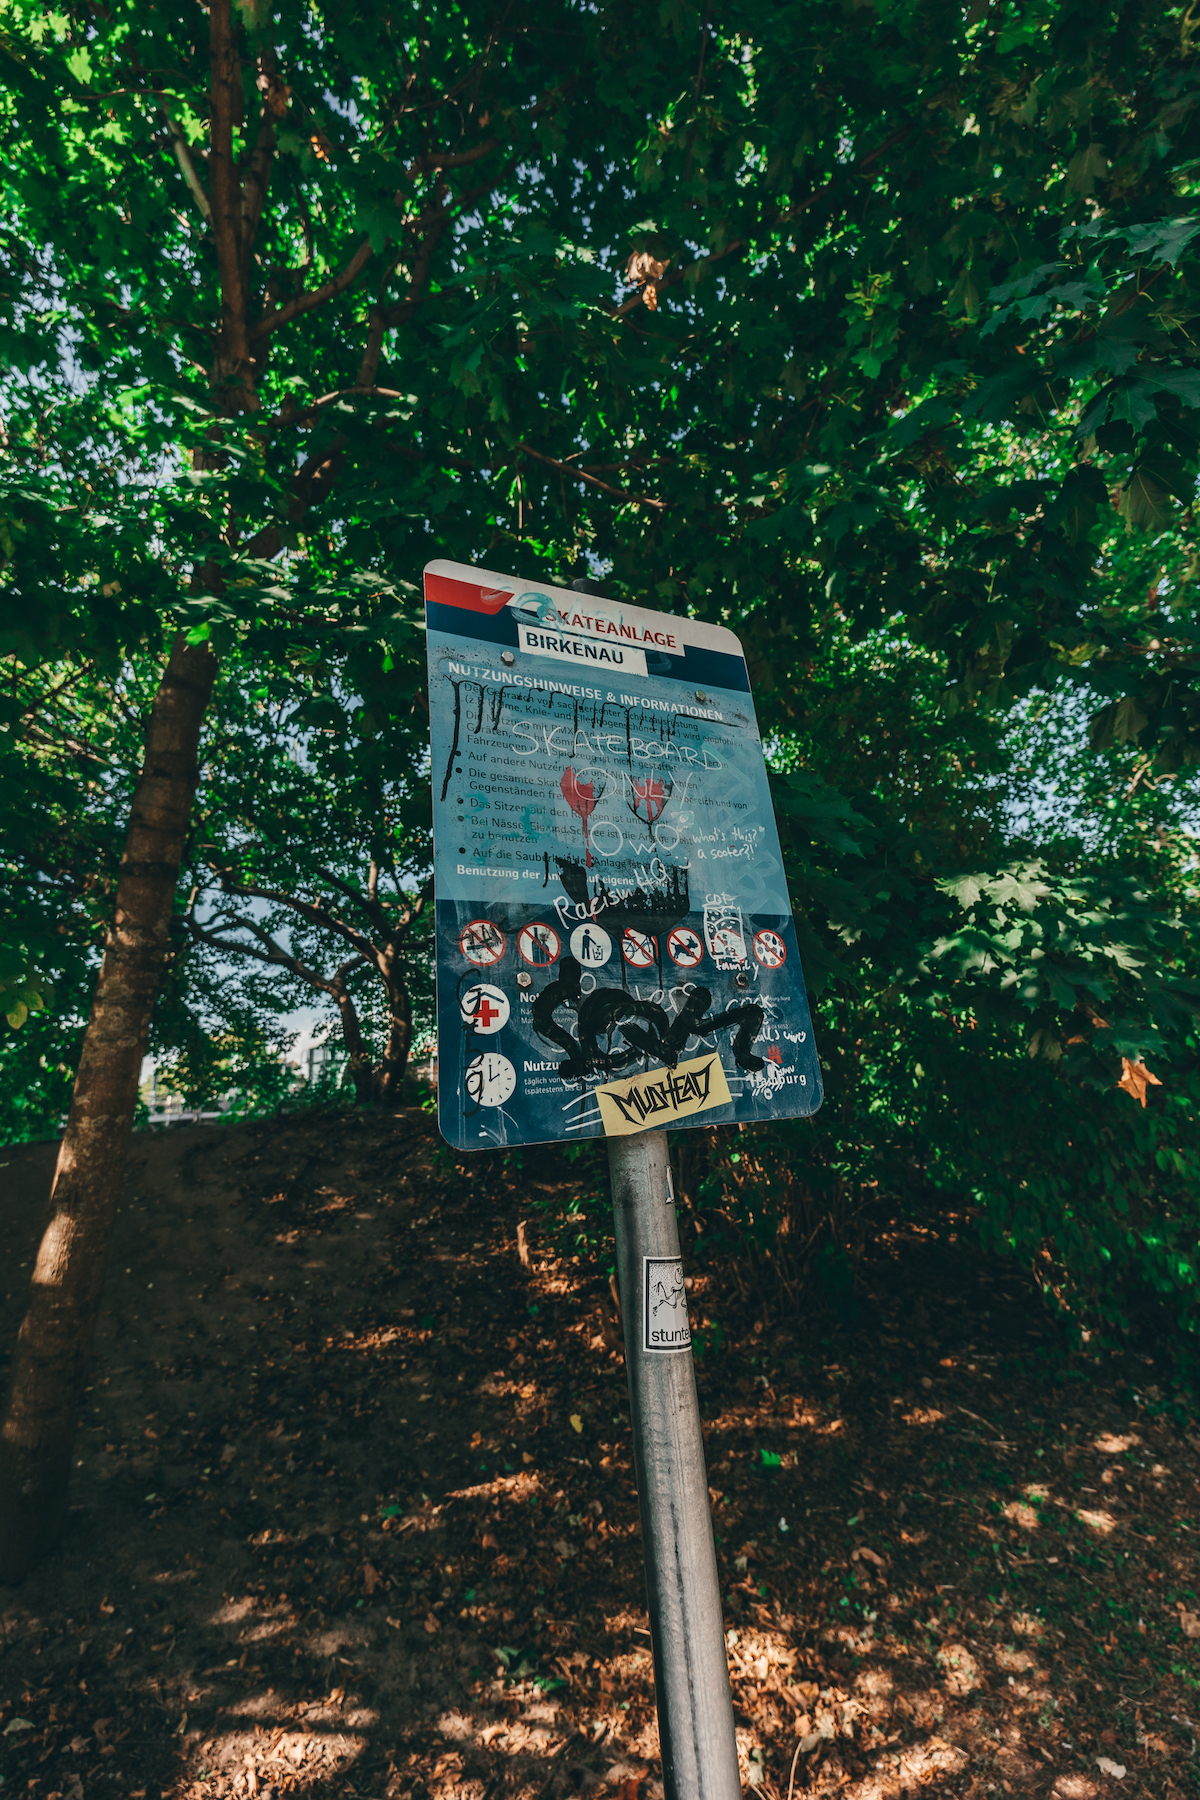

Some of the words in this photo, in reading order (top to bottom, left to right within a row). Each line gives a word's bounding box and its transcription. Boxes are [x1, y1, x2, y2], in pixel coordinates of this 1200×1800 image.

[544, 608, 676, 648] SKATEANLAGE
[525, 631, 624, 665] BIRKENAU
[448, 661, 602, 700] NUTZUNGSHINWEISE
[605, 690, 616, 703] &
[620, 693, 723, 721] INFORMATIONEN
[525, 705, 550, 717] Knie-
[553, 709, 571, 720] und
[683, 731, 700, 741] wird
[466, 734, 527, 752] Fahrzeugen
[638, 761, 677, 774] gestattet
[511, 721, 723, 771] SKATEBOARD
[468, 751, 487, 762] Auf
[490, 754, 525, 767] andere
[468, 768, 486, 778] Die
[489, 772, 534, 786] gesamte
[715, 799, 731, 808] und
[732, 802, 748, 810] von
[469, 779, 545, 798] Gegenständen
[574, 764, 693, 810] ONLY
[469, 797, 490, 809] Das
[494, 800, 528, 813] Sitzen
[530, 804, 547, 815] auf
[549, 807, 568, 817] den
[612, 814, 623, 822] ist
[470, 815, 488, 826] Bei
[606, 829, 619, 838] ist
[621, 831, 635, 840] die
[471, 832, 484, 840] zu
[488, 830, 538, 844] benutzen
[692, 827, 726, 843] what's
[731, 826, 757, 843] this?
[472, 847, 492, 858] Auf
[495, 849, 512, 859] die
[593, 857, 626, 869] Anlage
[697, 849, 707, 860] a
[456, 864, 520, 879] Benutzung
[521, 869, 540, 880] der
[601, 875, 634, 887] eigene
[524, 1076, 547, 1087] täglich
[525, 1086, 563, 1096] (spätestens
[598, 1056, 718, 1127] MUDHEAD
[750, 1073, 807, 1087] Hamburg
